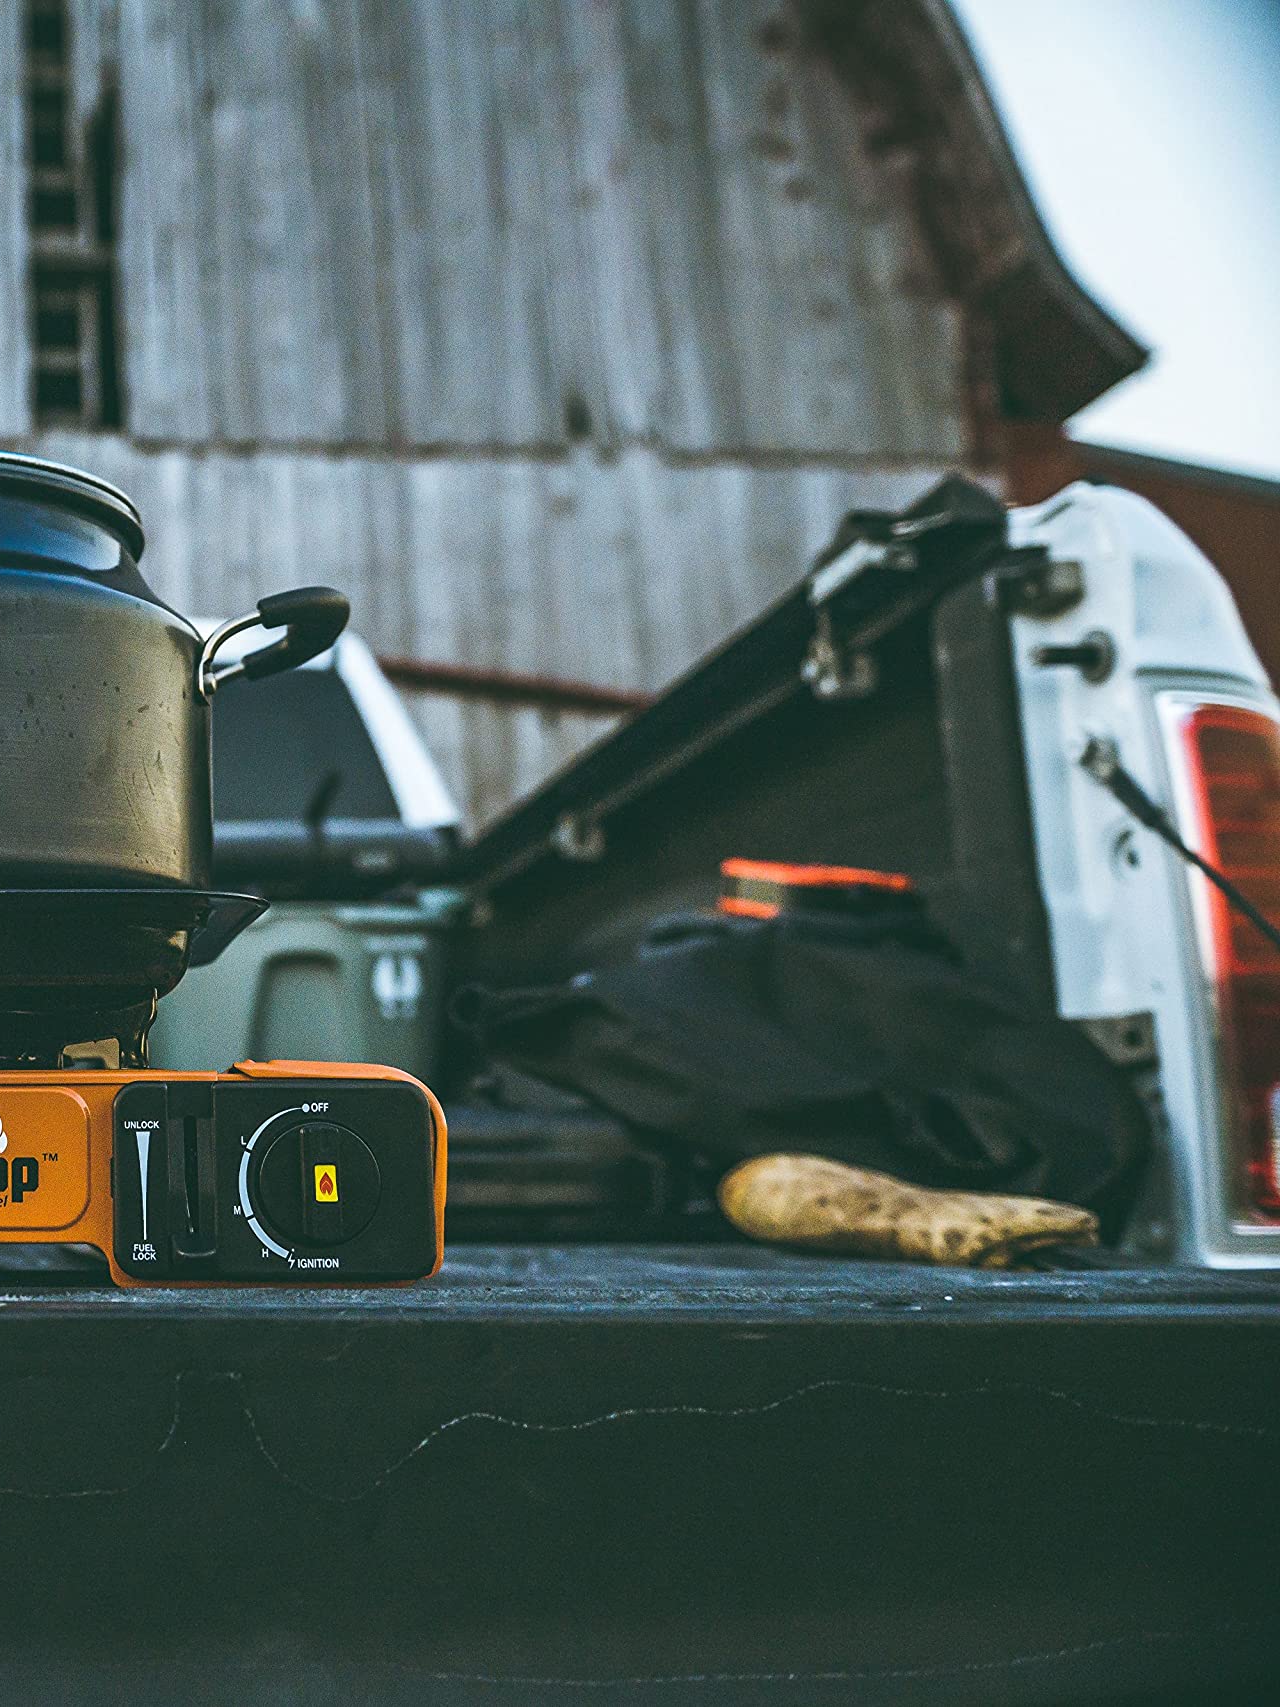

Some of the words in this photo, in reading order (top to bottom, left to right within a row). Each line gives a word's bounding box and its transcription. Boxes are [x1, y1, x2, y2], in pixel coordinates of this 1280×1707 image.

[310, 1102, 329, 1113] OFF
[124, 1120, 160, 1130] UNLOCK
[240, 1135, 247, 1146] L
[233, 1205, 242, 1216] M
[133, 1243, 156, 1252] FUEL
[132, 1252, 157, 1261] LOCK
[261, 1248, 269, 1258] H
[297, 1258, 340, 1269] IGNITION
